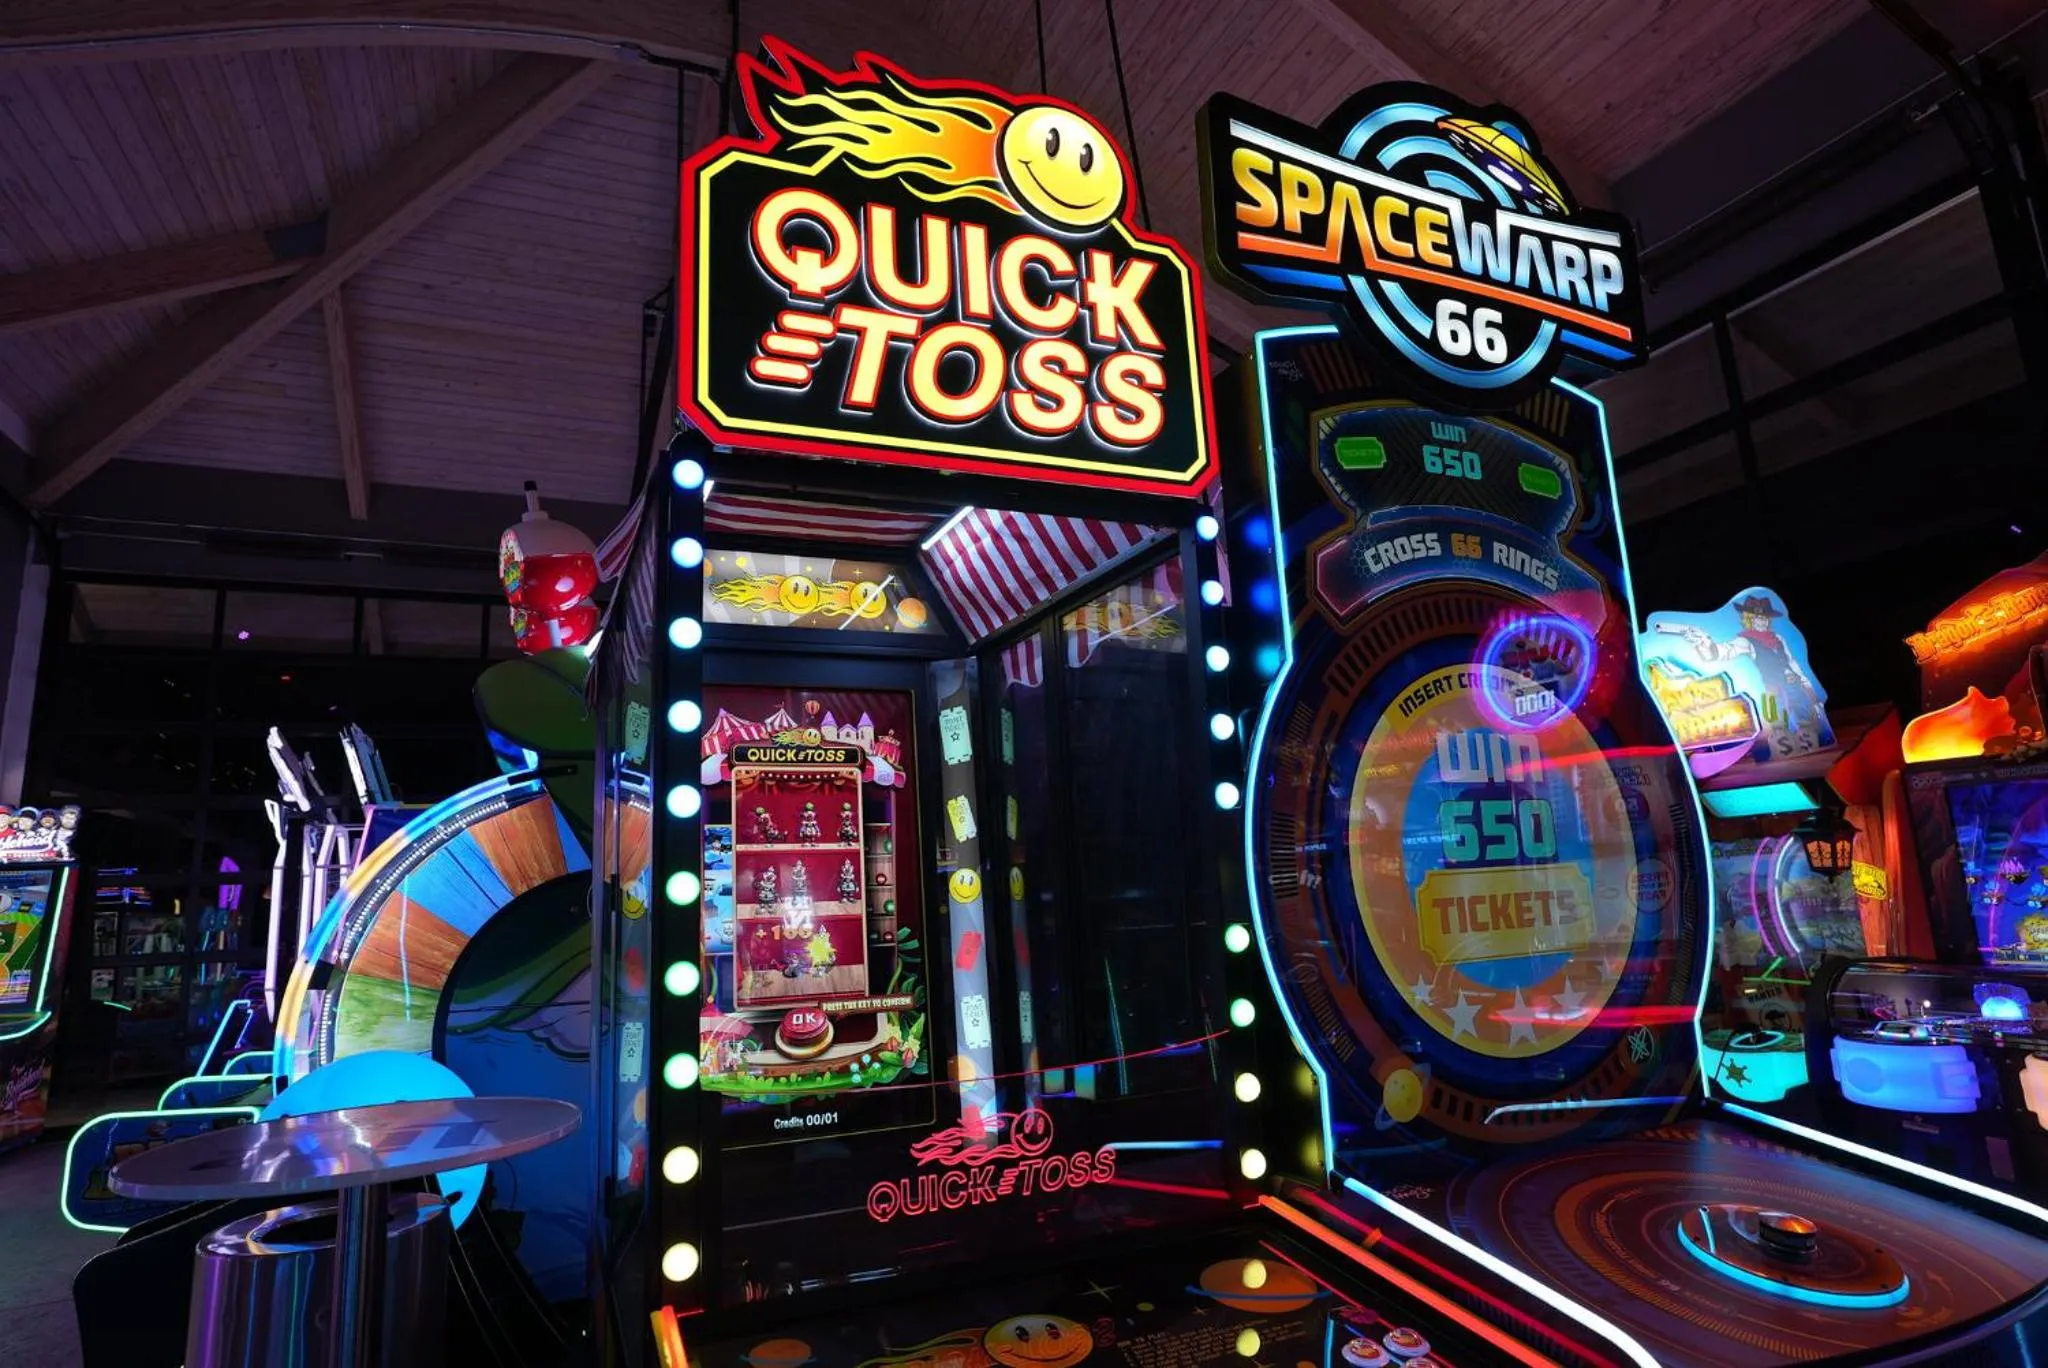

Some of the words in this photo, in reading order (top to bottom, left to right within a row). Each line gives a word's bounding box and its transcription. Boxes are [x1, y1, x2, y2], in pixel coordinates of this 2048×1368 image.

[750, 187, 1166, 352] QUICK
[1435, 298, 1508, 364] 66
[834, 304, 1166, 446] TOSS
[1430, 421, 1467, 443] WIN
[1422, 445, 1482, 480] 650
[1363, 533, 1442, 574] CROSS
[1451, 535, 1483, 560] 66
[1493, 542, 1561, 592] RINGS
[1399, 675, 1453, 718] INSERT
[747, 748, 797, 763] QUICK
[805, 749, 846, 763] TOSS
[1436, 732, 1544, 783] WIN
[1441, 798, 1559, 861] 650
[1432, 888, 1579, 935] TICKETS
[791, 1011, 817, 1026] OK
[773, 1116, 804, 1130] Credits
[806, 1111, 838, 1126] 00/01
[867, 1163, 995, 1223] QUICK
[1017, 1148, 1116, 1197] TOSS
